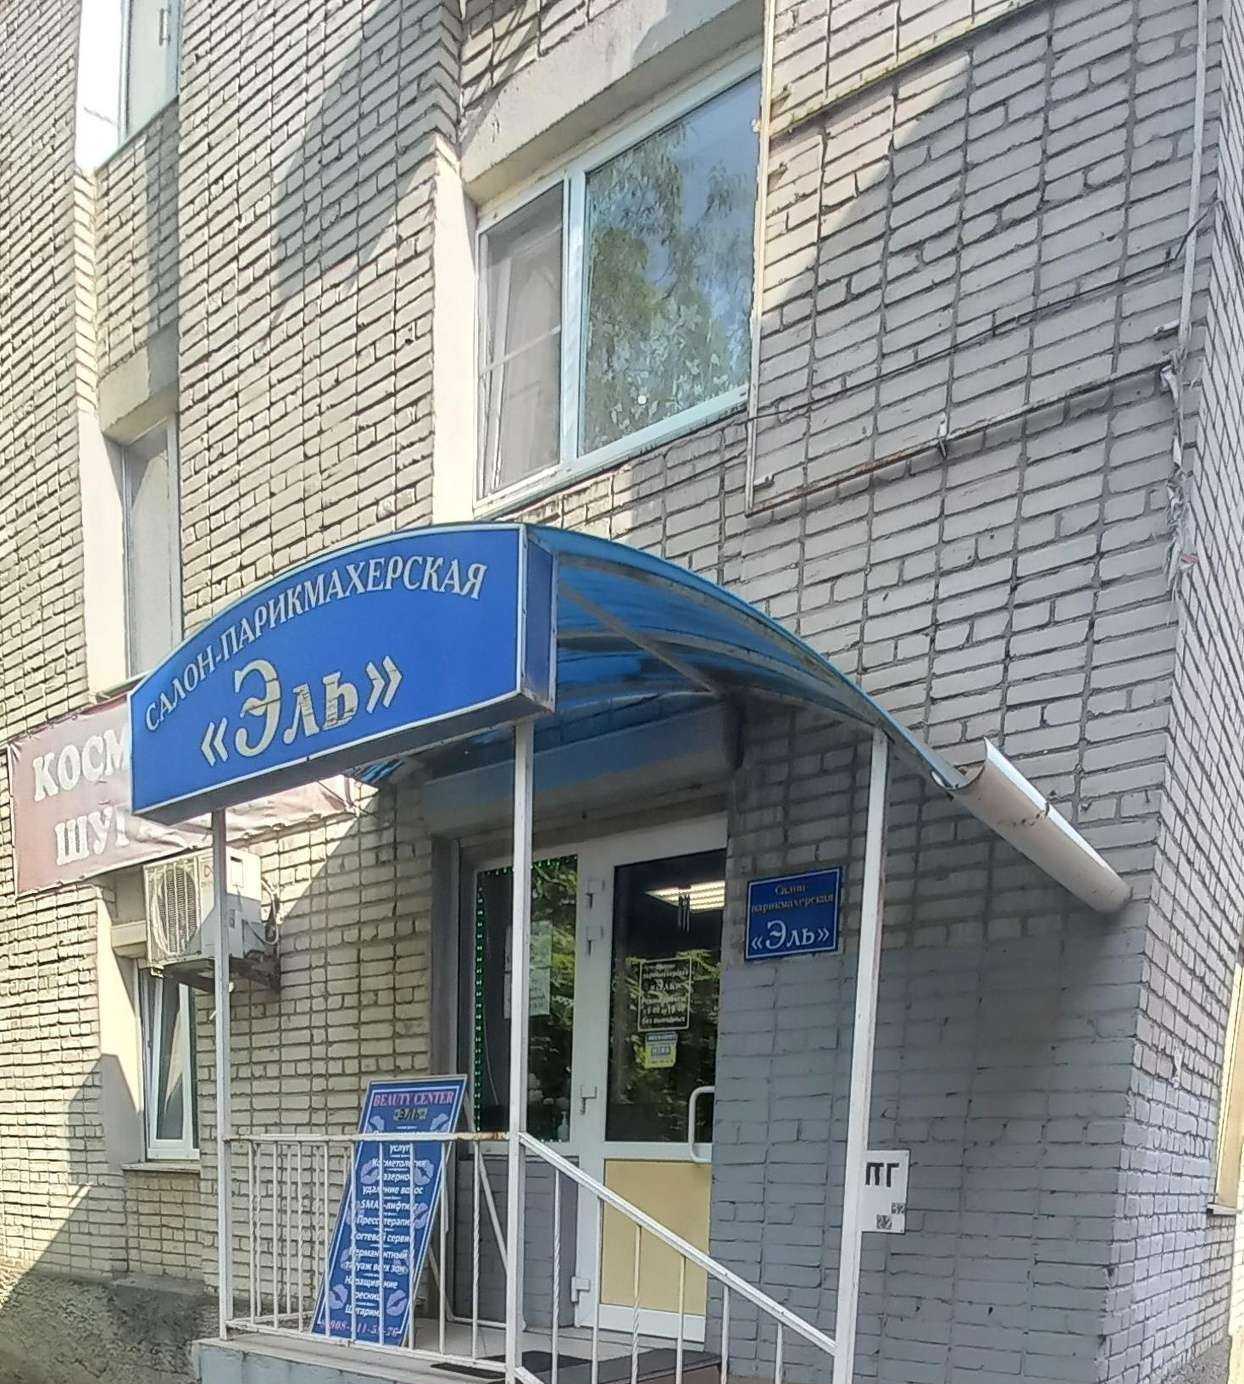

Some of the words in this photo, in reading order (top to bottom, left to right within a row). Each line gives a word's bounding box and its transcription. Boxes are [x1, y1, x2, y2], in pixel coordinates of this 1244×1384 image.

[145, 555, 487, 731] САЛОН-ПАРИКМАХЕРСКАЯ
[200, 655, 403, 767] «Эль»
[751, 919, 830, 951] «Эль»
[373, 1093, 410, 1107] BEAUTY
[414, 1091, 454, 1105] CENTER
